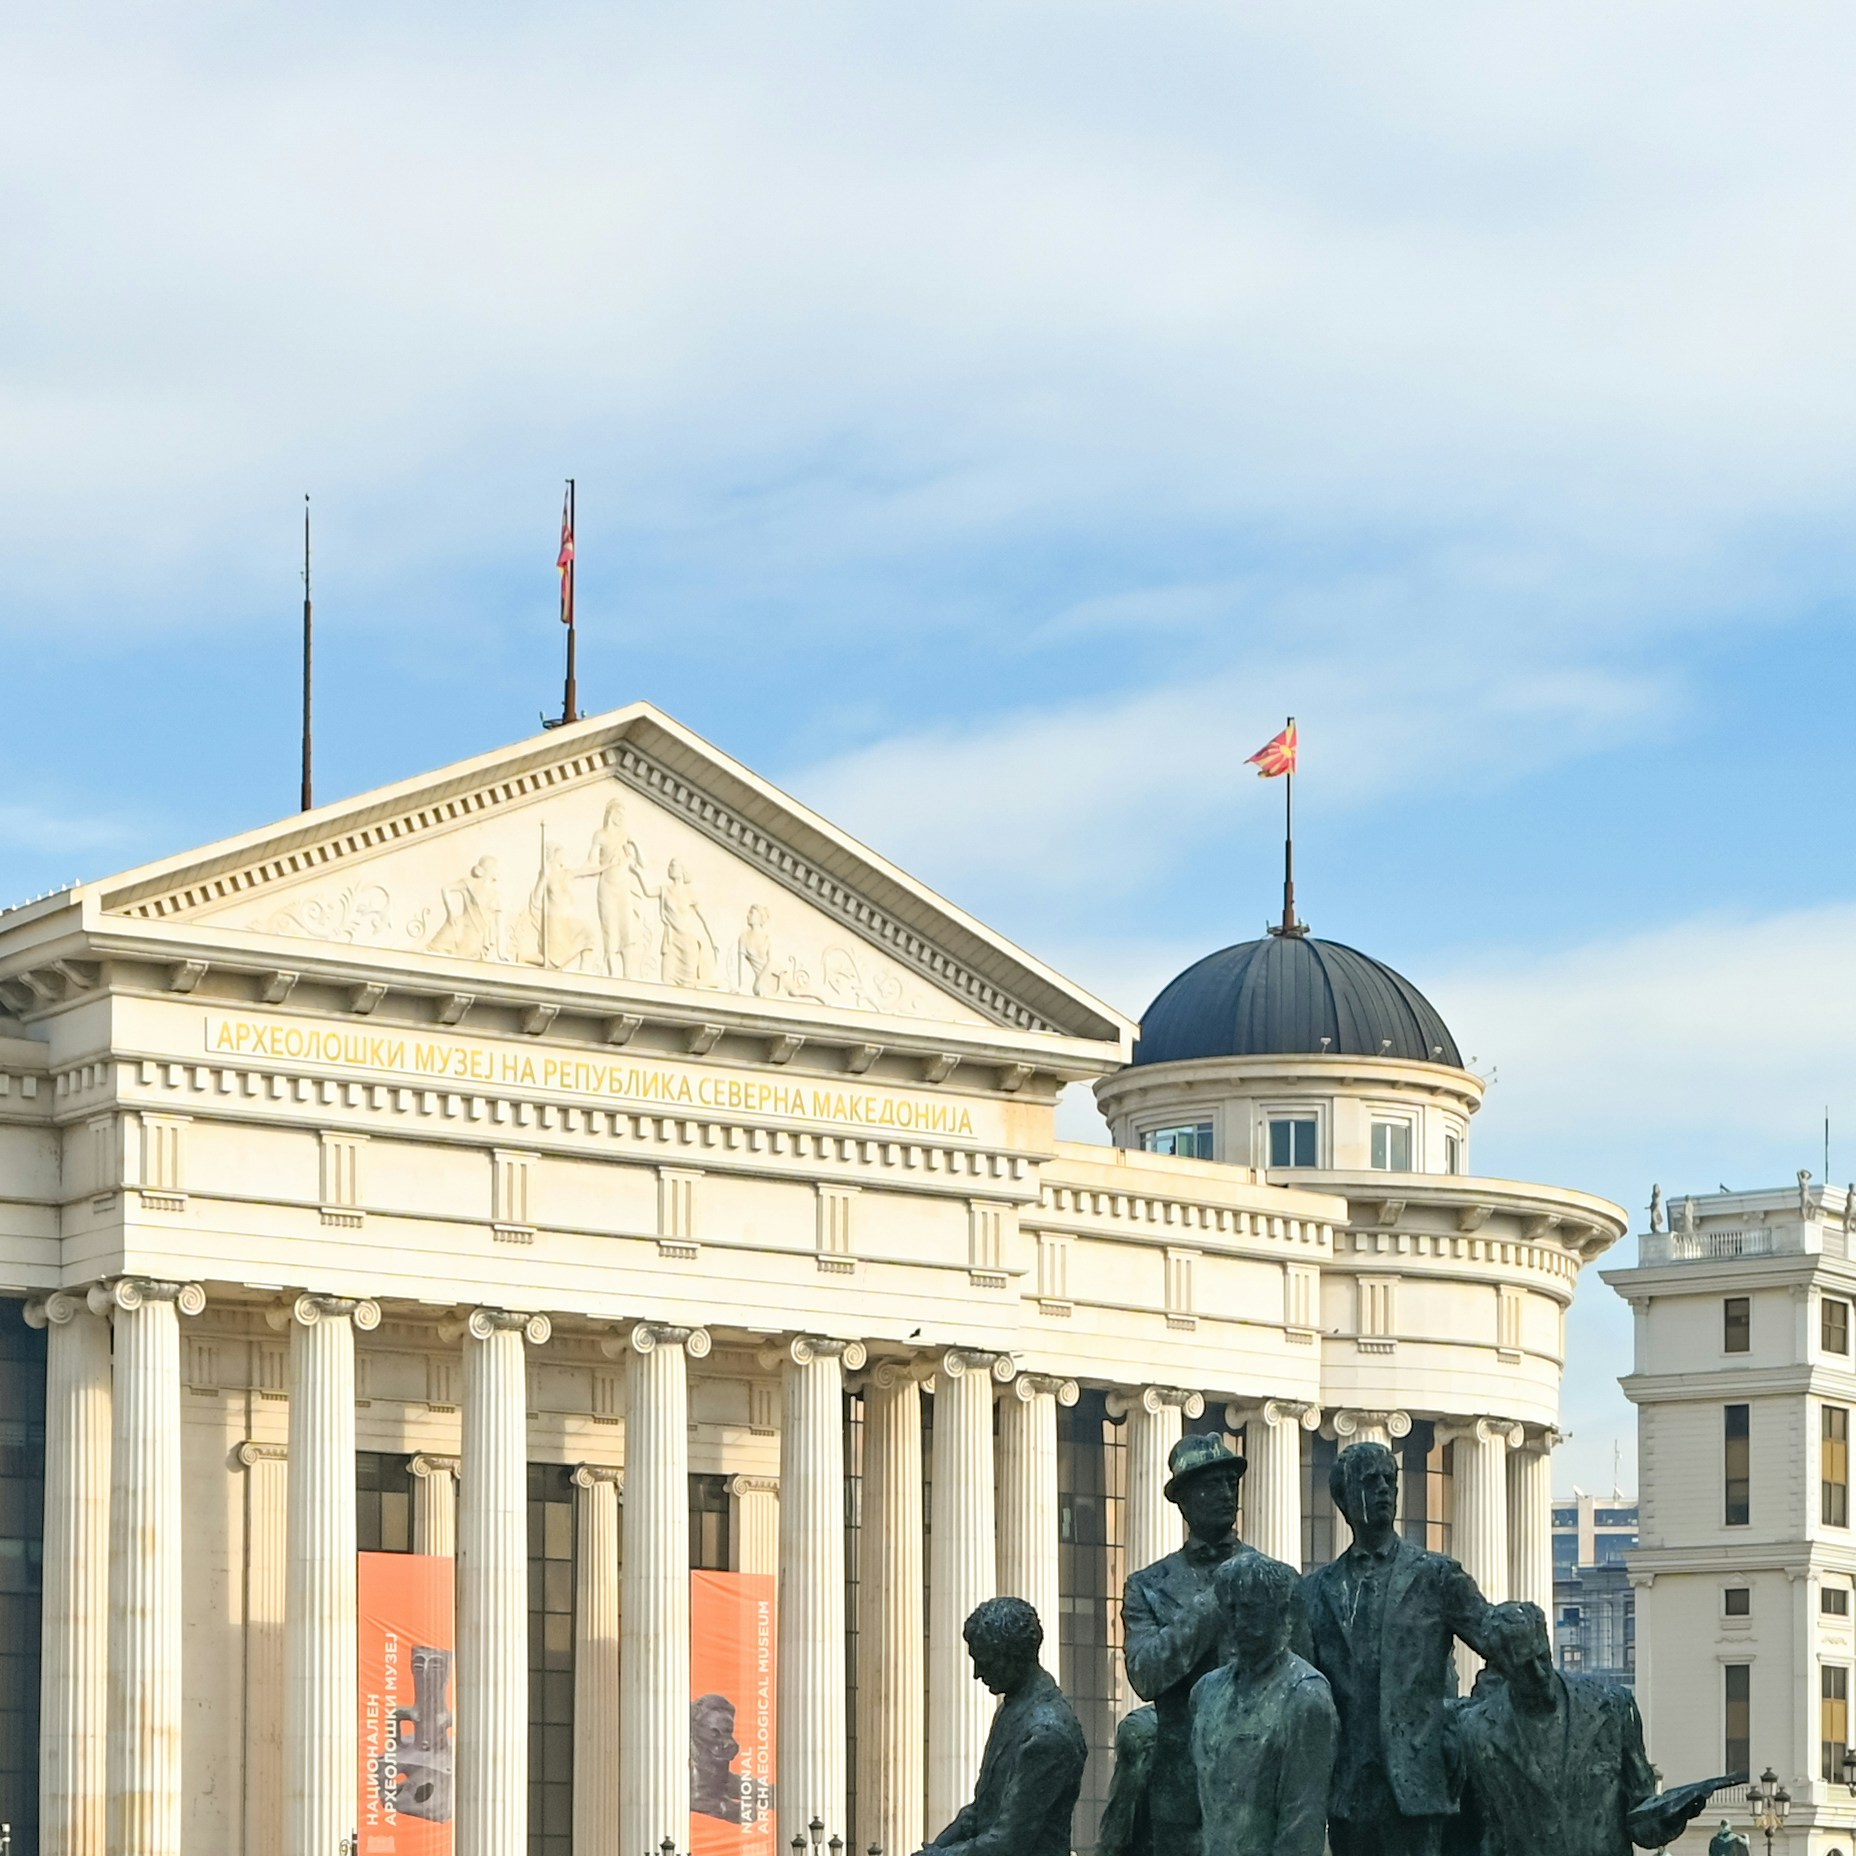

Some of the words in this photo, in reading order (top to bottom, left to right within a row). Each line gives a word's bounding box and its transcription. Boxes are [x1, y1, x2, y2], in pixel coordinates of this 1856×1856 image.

[217, 1020, 404, 1068] АРХЕОЛОШКИ
[415, 1043, 494, 1080] МУЗЕЈ
[503, 1055, 535, 1084] НА
[544, 1059, 692, 1103] РЕПУБЛИКА
[699, 1077, 805, 1115] СЕВЕРНА
[813, 1091, 972, 1134] МАКЕДОНИЈА
[385, 1632, 398, 1690] МУЗЕЈ
[757, 1601, 769, 1672] MUSEUM
[367, 1694, 380, 1825] НАЦИОНАЛЕН
[384, 1695, 398, 1825] АРХЕОЛОШКИ
[741, 1746, 753, 1834] NATIONAL
[757, 1676, 769, 1834] ARCHAEOLOGICAL
